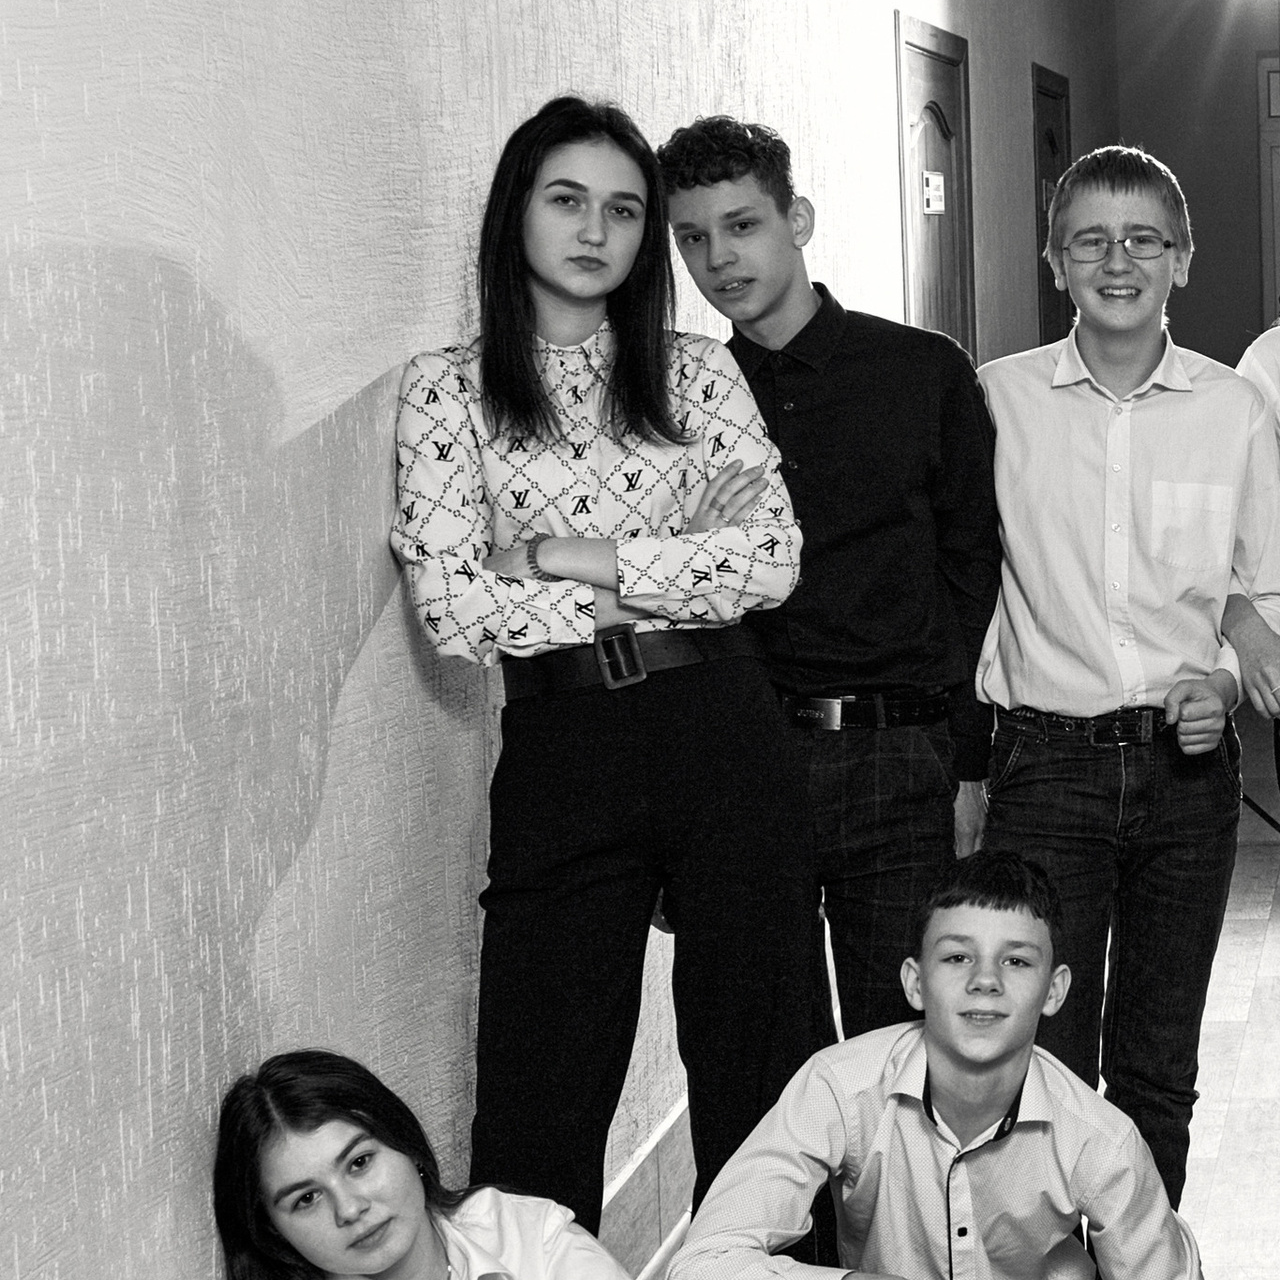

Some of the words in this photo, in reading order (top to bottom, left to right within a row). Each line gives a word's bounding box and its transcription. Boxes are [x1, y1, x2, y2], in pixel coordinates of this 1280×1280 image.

[432, 441, 455, 463] LV
[568, 442, 587, 460] LV
[622, 469, 643, 493] LV
[510, 489, 532, 510] LV
[571, 495, 592, 516] LV
[402, 501, 419, 525] LV
[757, 533, 782, 559] LV
[454, 560, 479, 585] LV
[691, 564, 712, 589] LV
